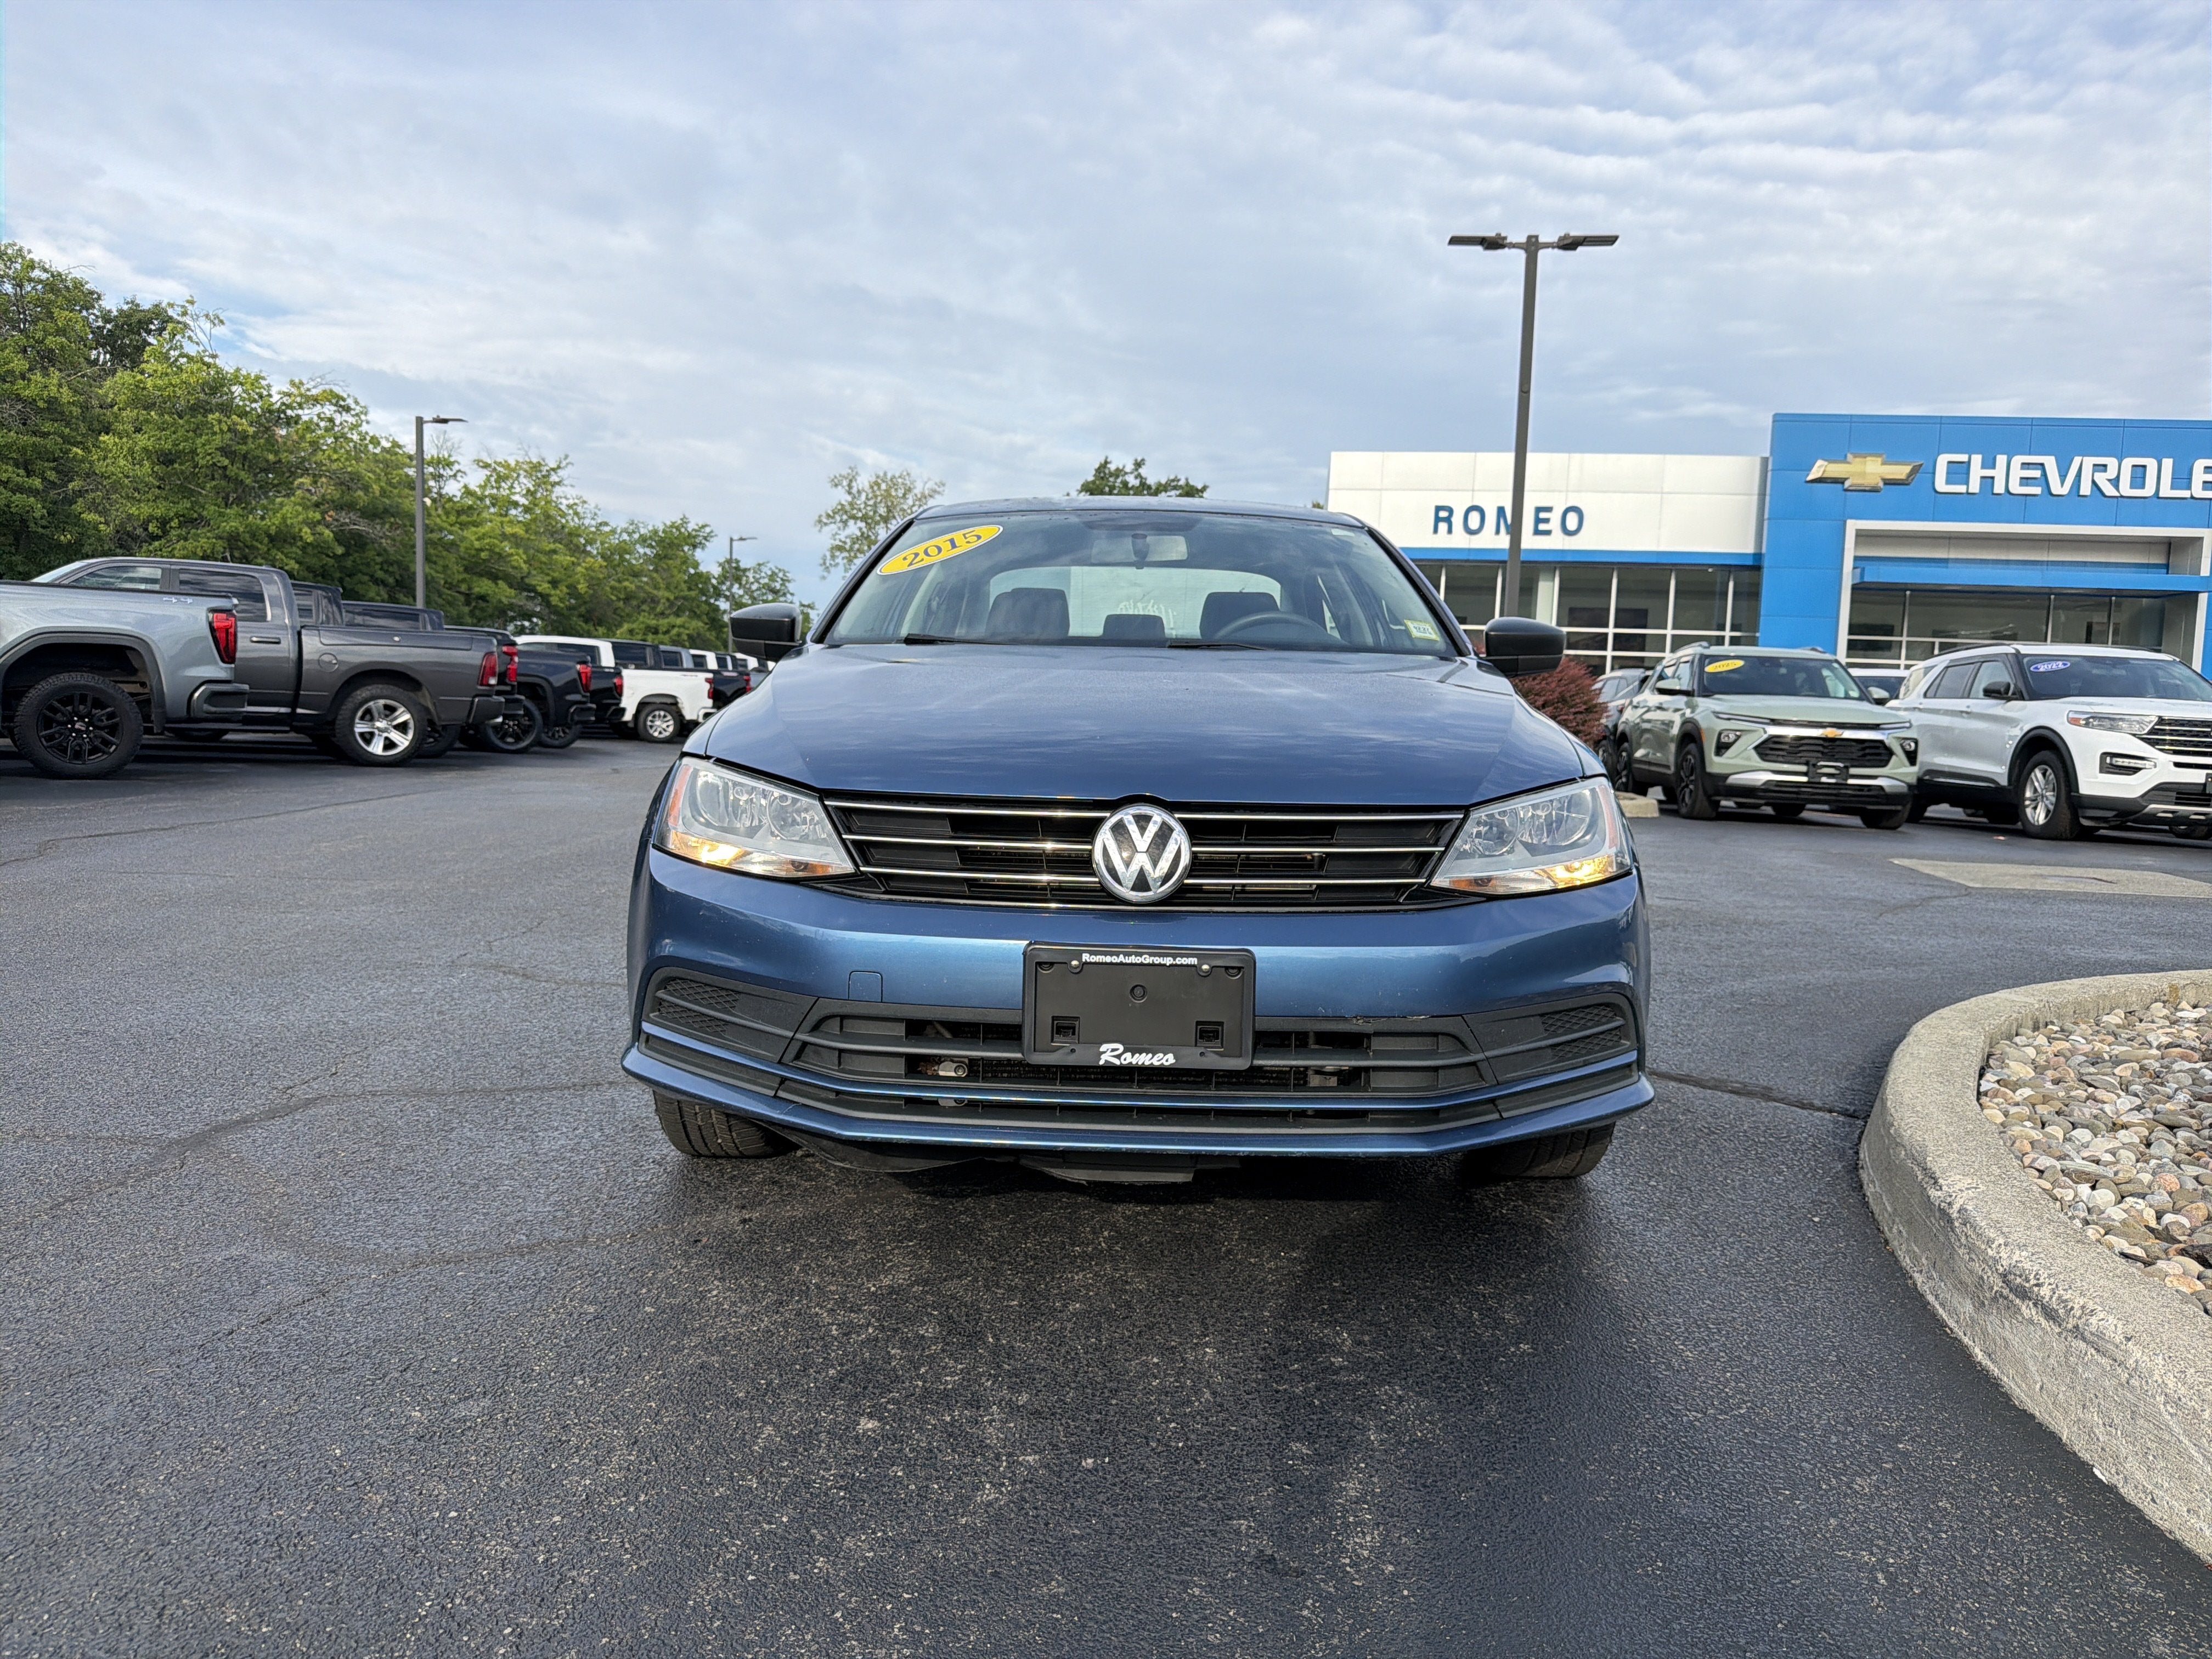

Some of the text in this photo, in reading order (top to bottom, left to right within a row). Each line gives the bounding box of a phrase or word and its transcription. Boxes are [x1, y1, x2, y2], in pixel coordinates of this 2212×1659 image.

[902, 530, 982, 567] 2015
[1082, 953, 1198, 966] RomeoAutoGroup.com
[1099, 1043, 1176, 1065] Romeo
